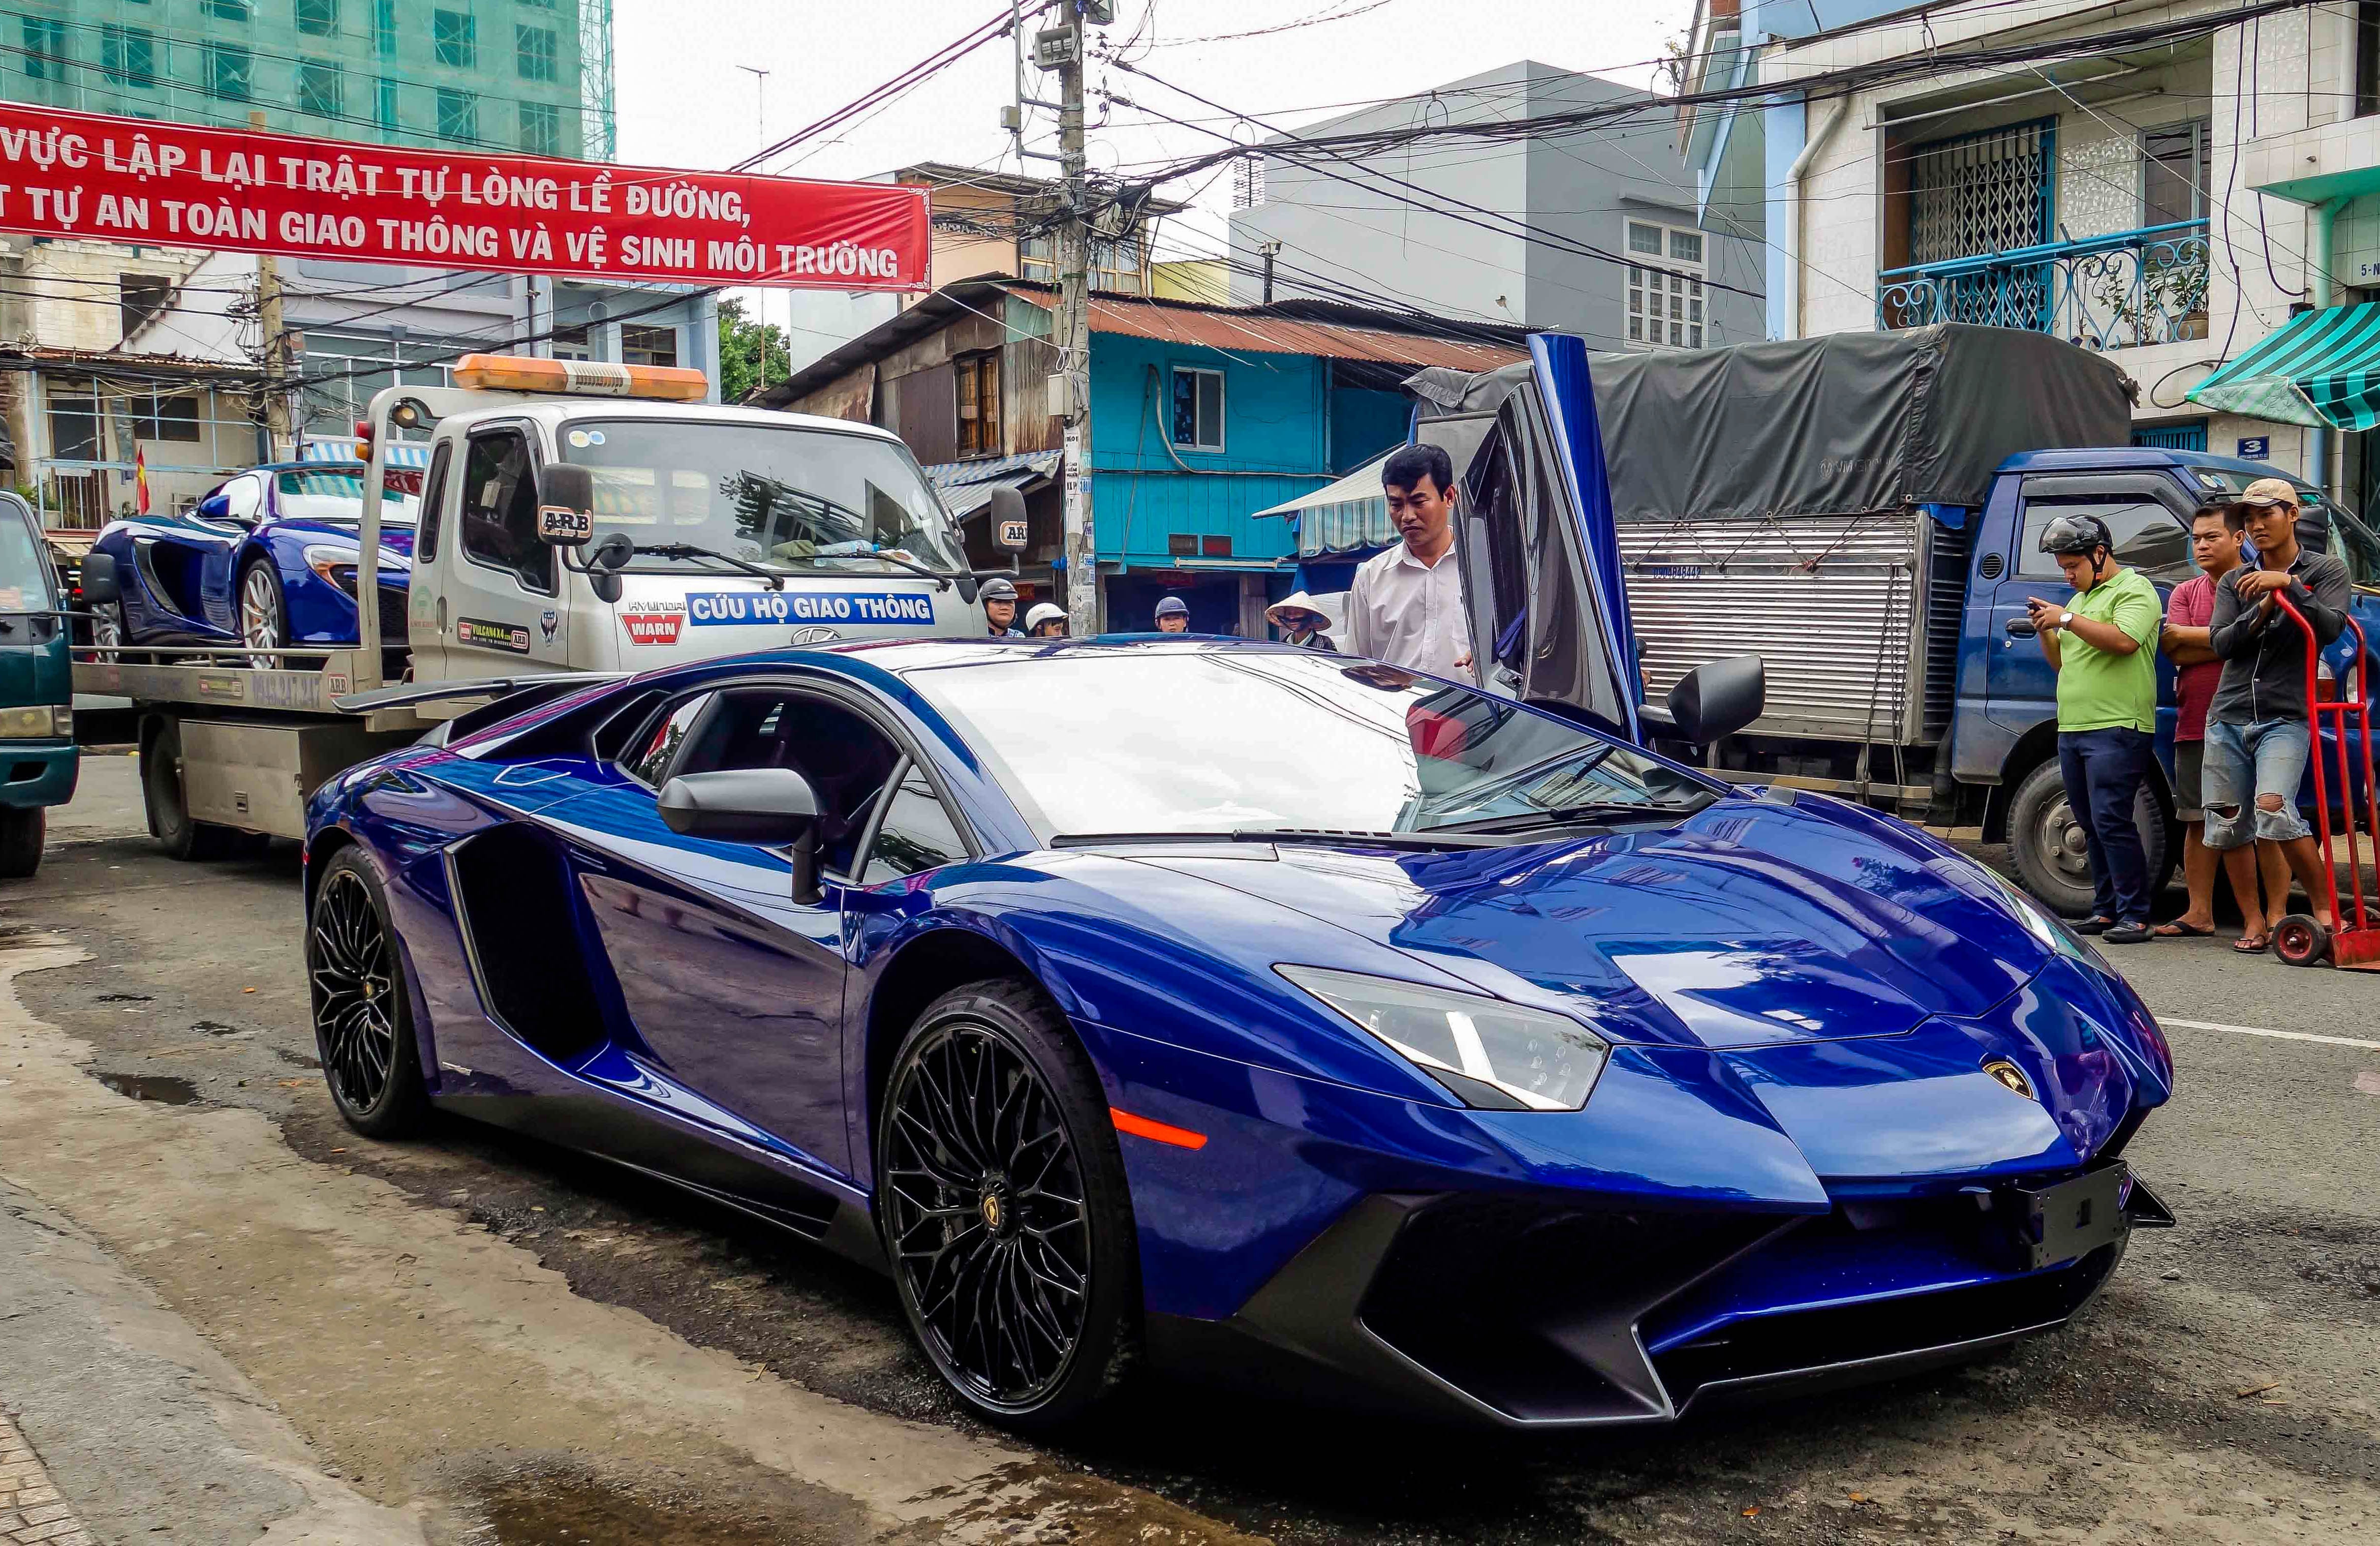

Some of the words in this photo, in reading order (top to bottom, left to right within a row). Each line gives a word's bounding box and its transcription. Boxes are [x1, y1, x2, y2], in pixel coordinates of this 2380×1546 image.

[0, 126, 88, 171] VỰC
[104, 133, 186, 181] LẬP
[201, 149, 265, 191] LẠI
[279, 154, 385, 200] TRẬT
[396, 166, 449, 207] TỰ
[462, 166, 558, 210] LÒNG
[571, 170, 612, 214] LỀ
[626, 180, 750, 228] ĐƯỜNG,
[25, 185, 83, 230] TỰ
[96, 194, 149, 230] AN
[162, 197, 266, 240] TOÀN
[280, 211, 365, 247] GIAO
[377, 215, 498, 258] THÔNG
[509, 222, 553, 260] VÀ
[566, 226, 607, 269] VỆ
[620, 235, 695, 268] SINH
[708, 235, 765, 272] MÔI
[776, 239, 898, 278] TRƯỜNG
[2244, 440, 2262, 453] 3
[543, 512, 589, 531] ARB
[1007, 527, 1027, 539] AR
[629, 601, 687, 611] HYUNDAI
[692, 594, 746, 619] CỨU
[754, 594, 788, 623] HỘ
[795, 597, 850, 619] GIAO
[854, 593, 931, 619] THÔNG
[631, 623, 676, 635] WARN
